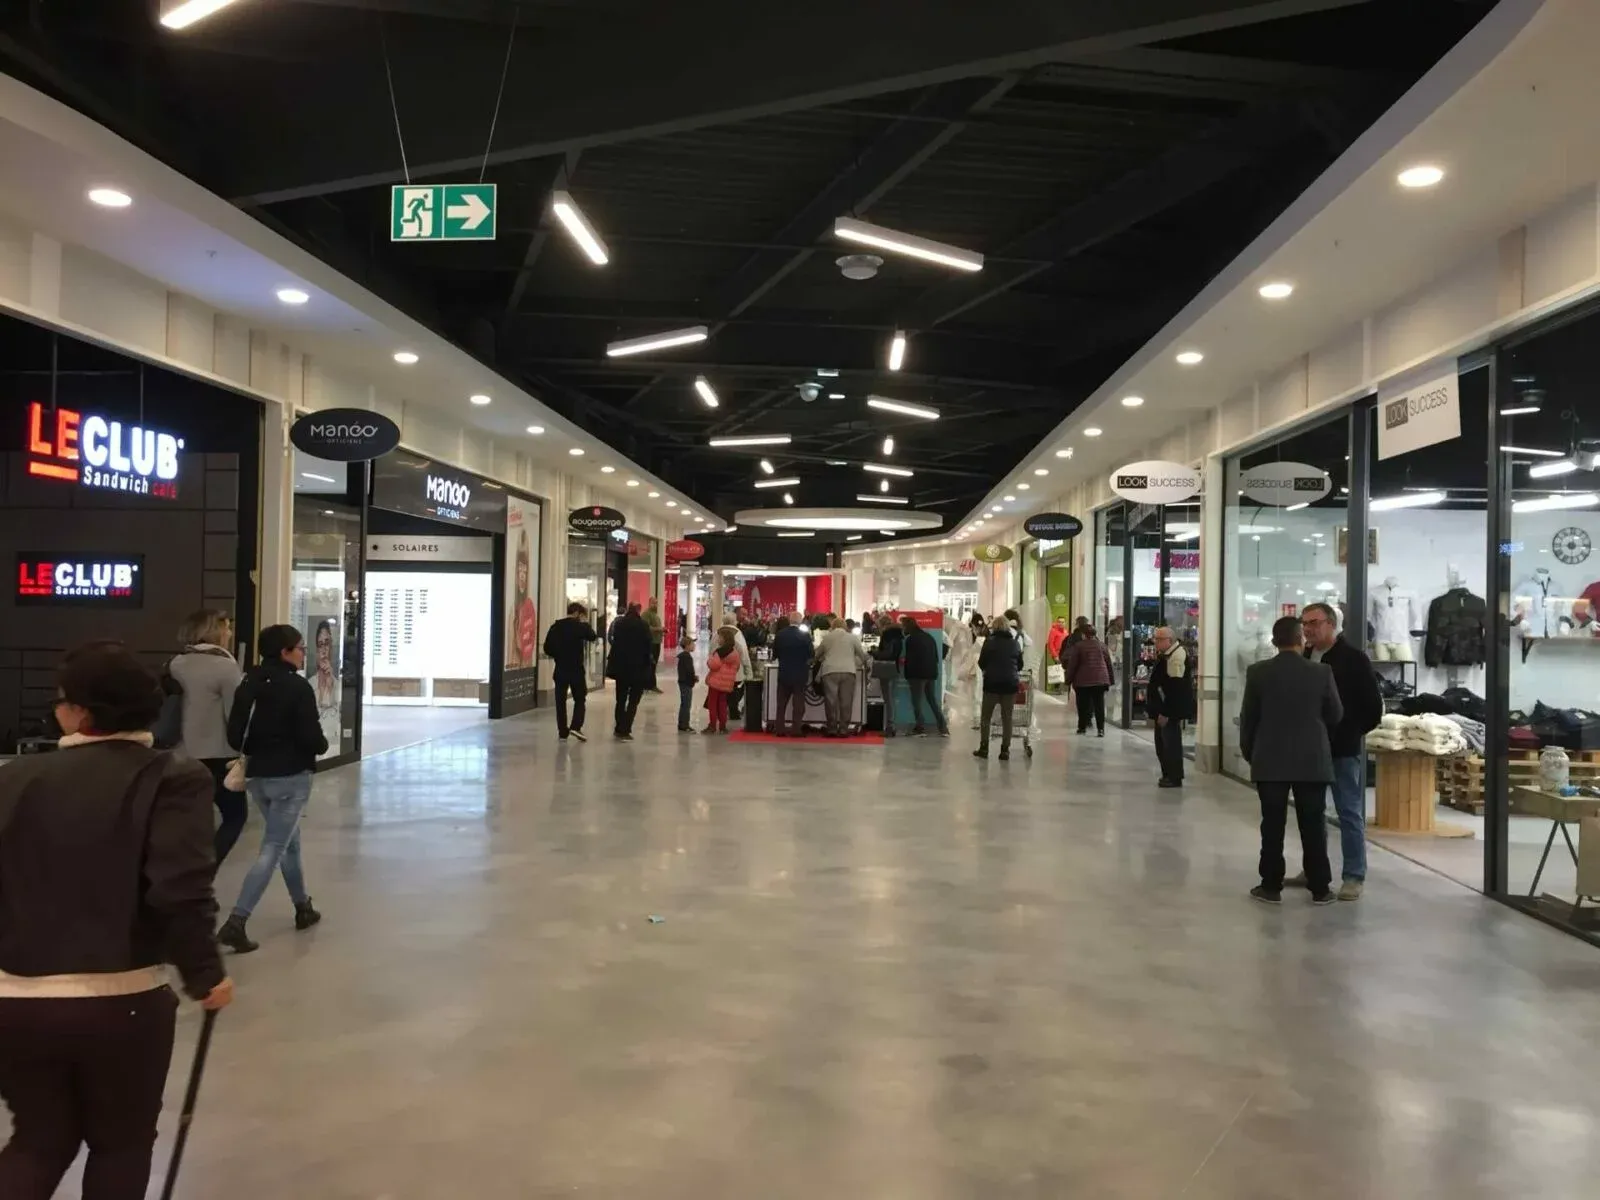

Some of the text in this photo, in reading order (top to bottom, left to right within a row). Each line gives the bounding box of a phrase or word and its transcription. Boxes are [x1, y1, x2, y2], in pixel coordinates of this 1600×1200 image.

[1387, 387, 1448, 424] LOOK SUCCESS
[83, 466, 149, 495] Sandwich
[1119, 478, 1195, 488] LOOK SUCCESS
[392, 544, 439, 552] SOLAIRES
[55, 586, 107, 596] Sandwich
